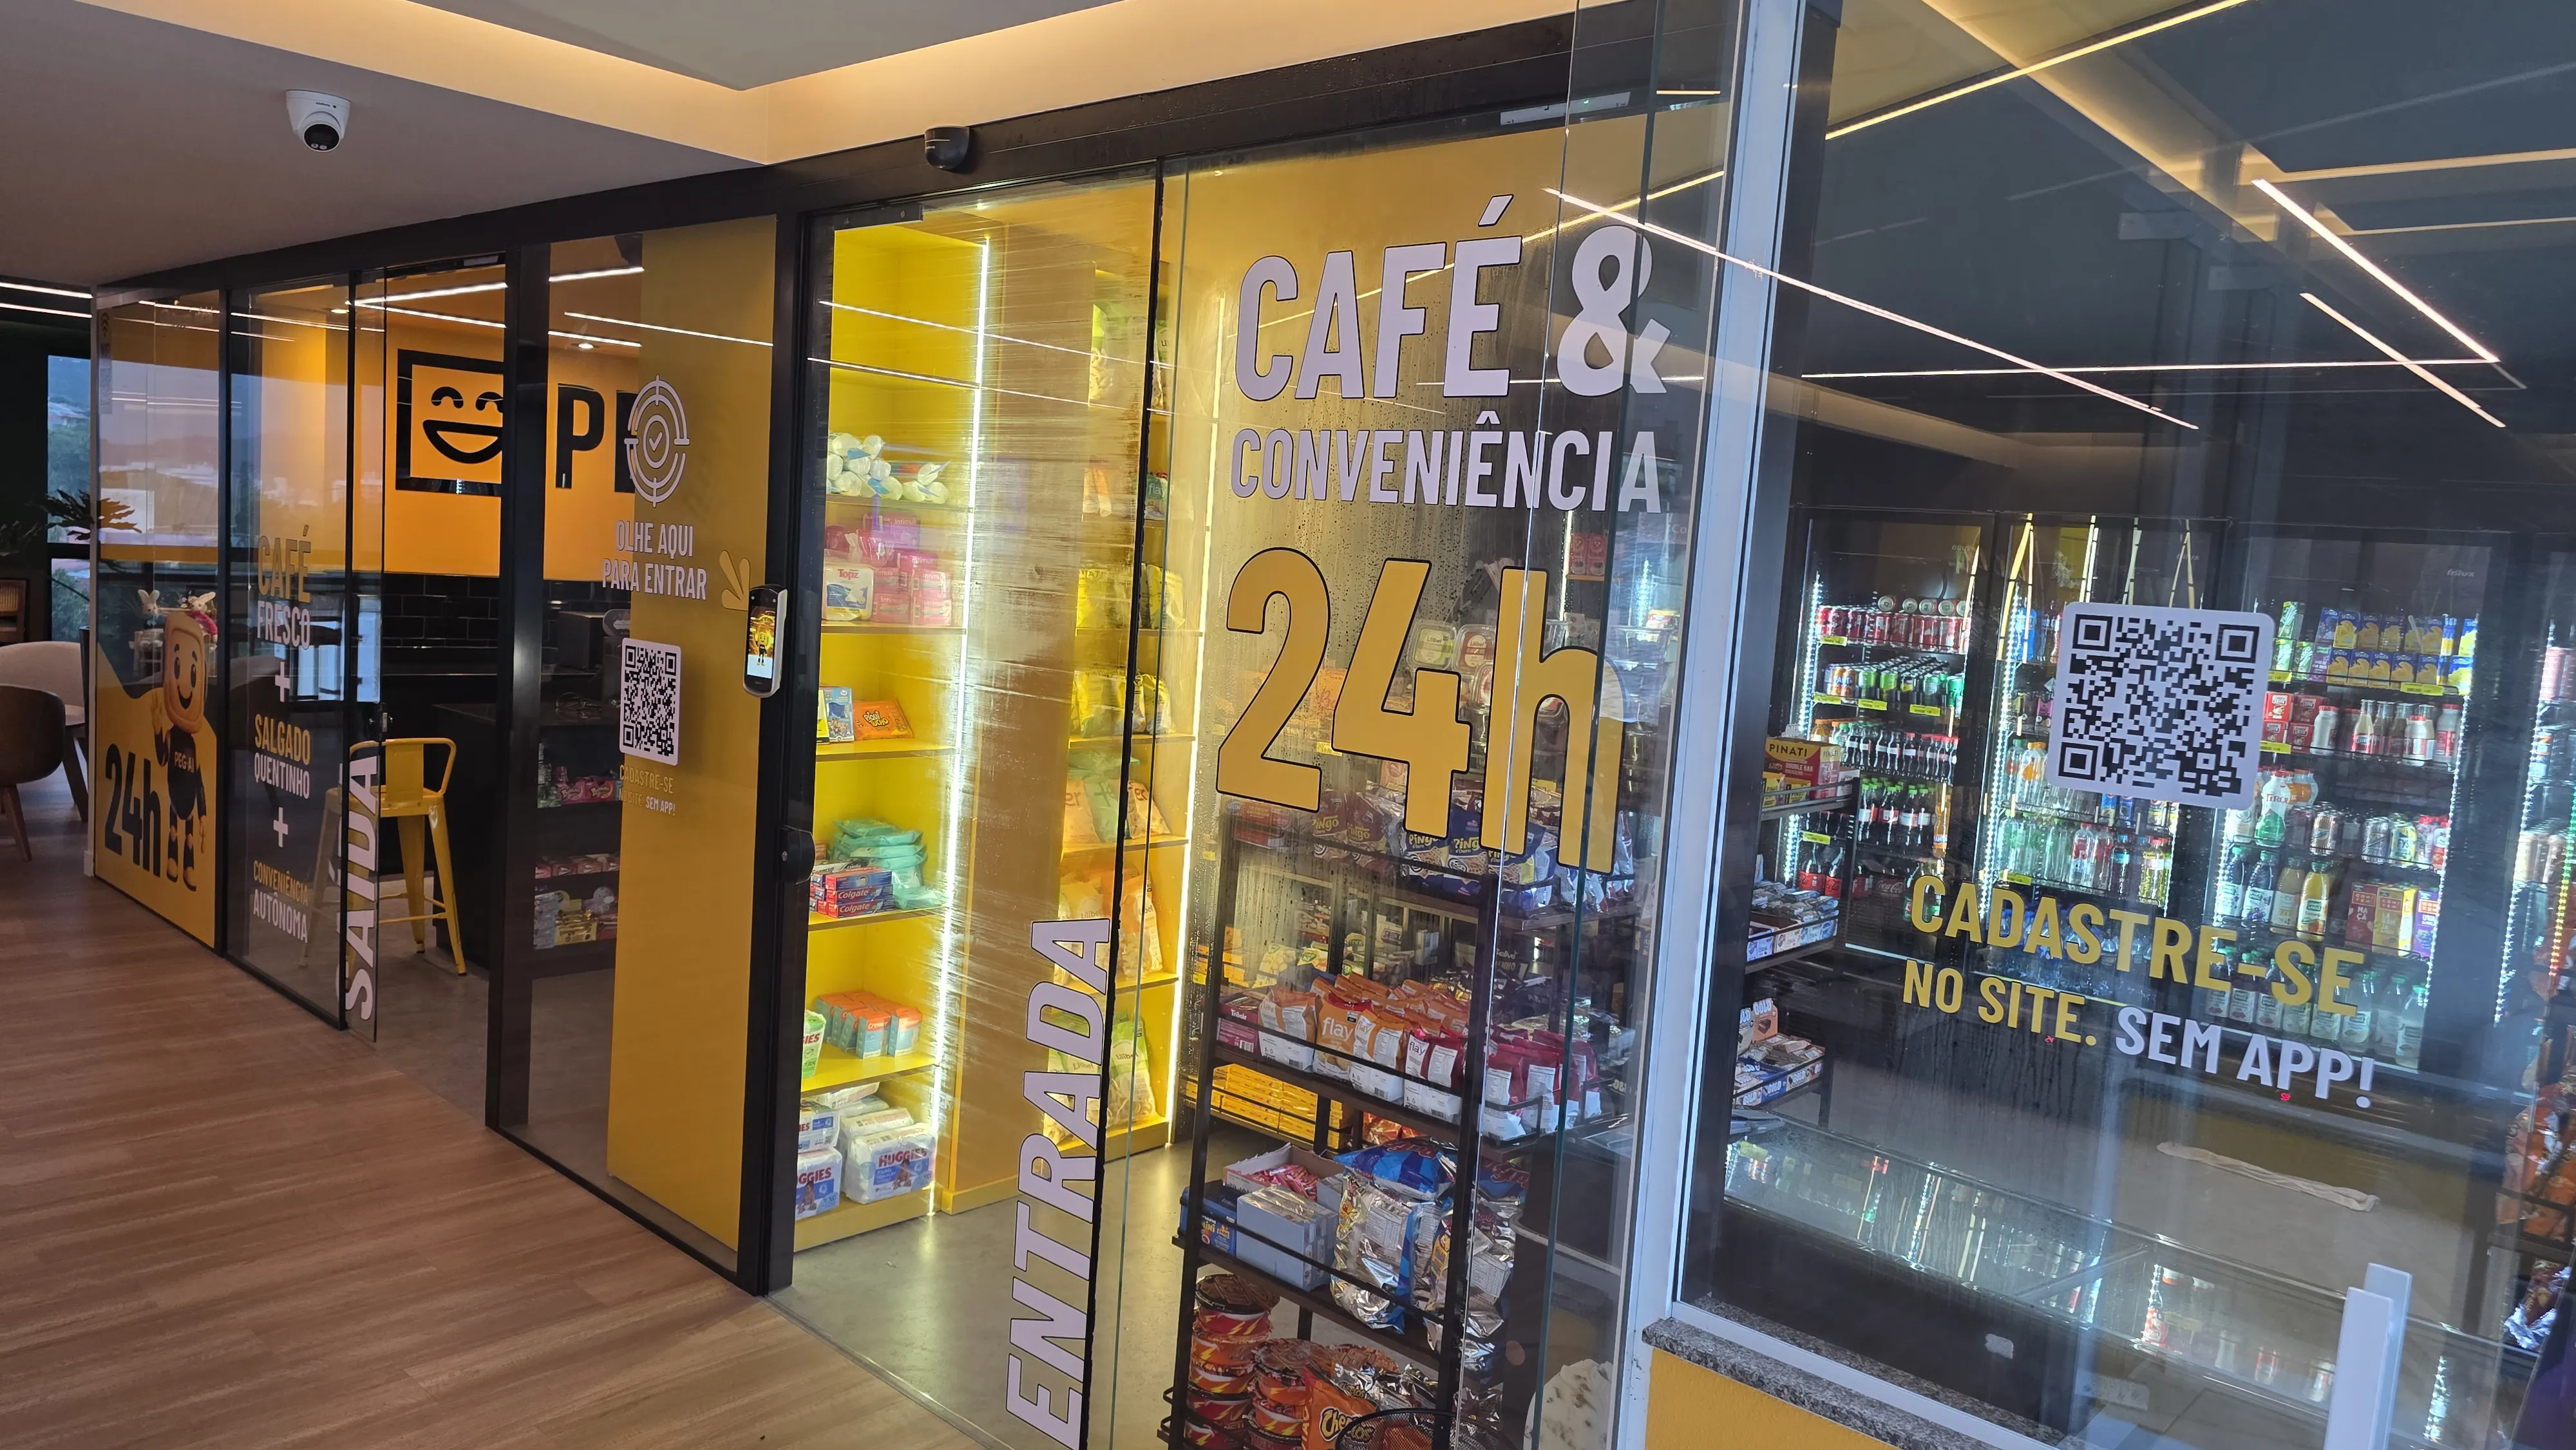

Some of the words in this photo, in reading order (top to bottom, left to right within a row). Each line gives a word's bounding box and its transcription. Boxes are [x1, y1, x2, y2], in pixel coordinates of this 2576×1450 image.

[1235, 194, 1522, 401] CAFÉ
[1556, 225, 1672, 397] &
[1231, 410, 1662, 514] CONVENIÊNCIA
[258, 524, 312, 603] CAFÉ
[616, 520, 653, 554] OLHE
[658, 523, 694, 560] AQUI
[601, 558, 640, 592] PARA
[645, 563, 706, 601] ENTRAR
[838, 569, 859, 580] Topz
[257, 600, 310, 650] FRESCO
[1216, 547, 1625, 874] 24h
[254, 713, 311, 766] SALGADO
[1769, 744, 1808, 757] PINATI
[254, 752, 310, 800] QUENTINHO
[619, 764, 674, 794] CADASTRE-SE
[105, 743, 161, 878] 24h
[645, 796, 659, 812] SEM
[660, 802, 676, 816] APP!
[253, 860, 308, 906] CONVENIÊNCIA
[838, 890, 869, 899] Colgate
[252, 889, 308, 943] AUTÔNOMA
[839, 902, 870, 913] Colgate
[1911, 875, 2364, 1017] CADASTRE-SE
[1322, 1017, 1354, 1041] flay
[1409, 1040, 1426, 1056] flay
[1902, 959, 1963, 1013] NO
[1978, 977, 2097, 1046] SITE.
[2115, 1006, 2222, 1074] SEM
[2237, 1034, 2375, 1109] APP!
[798, 1167, 832, 1184] GGIES
[1006, 919, 1110, 1450] ENTRADA
